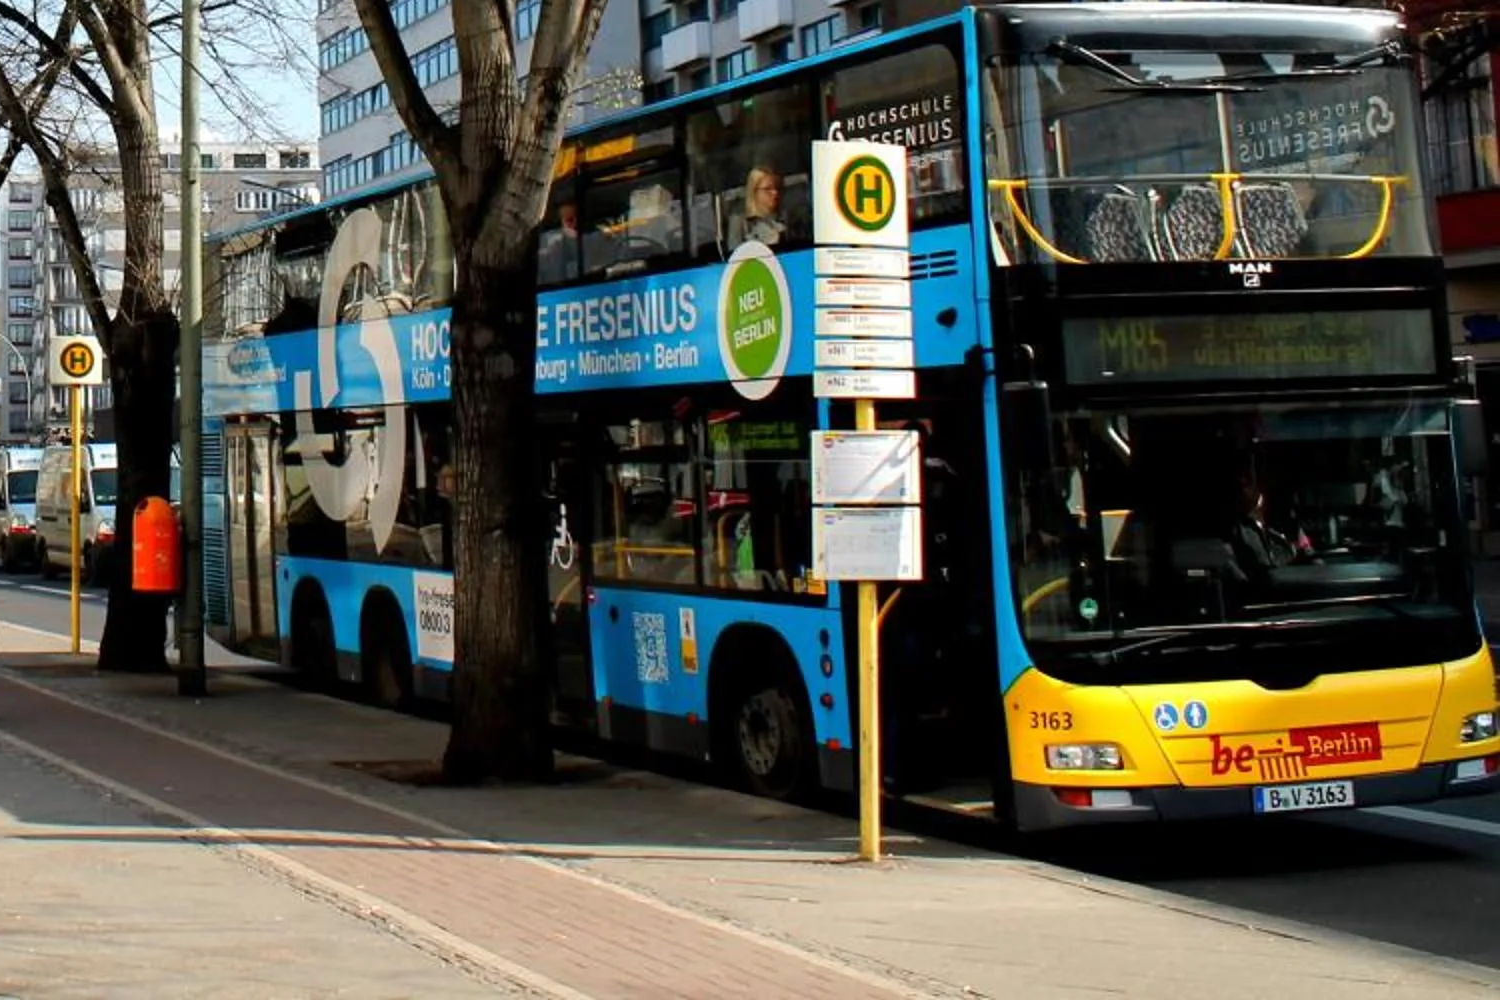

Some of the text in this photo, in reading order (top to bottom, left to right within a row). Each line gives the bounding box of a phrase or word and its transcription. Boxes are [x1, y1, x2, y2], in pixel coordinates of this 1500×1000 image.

[846, 94, 953, 132] HOCHSCHULE
[1228, 262, 1273, 274] MAN
[555, 283, 697, 345] FRESENIUS
[738, 286, 765, 314] NEU
[732, 316, 776, 349] BERLIN
[411, 365, 435, 389] Köln
[578, 347, 642, 377] München
[654, 340, 698, 370] Berlin
[1029, 711, 1073, 731] 3163
[1209, 731, 1373, 776] be Berlin
[1306, 785, 1347, 805] 3163
